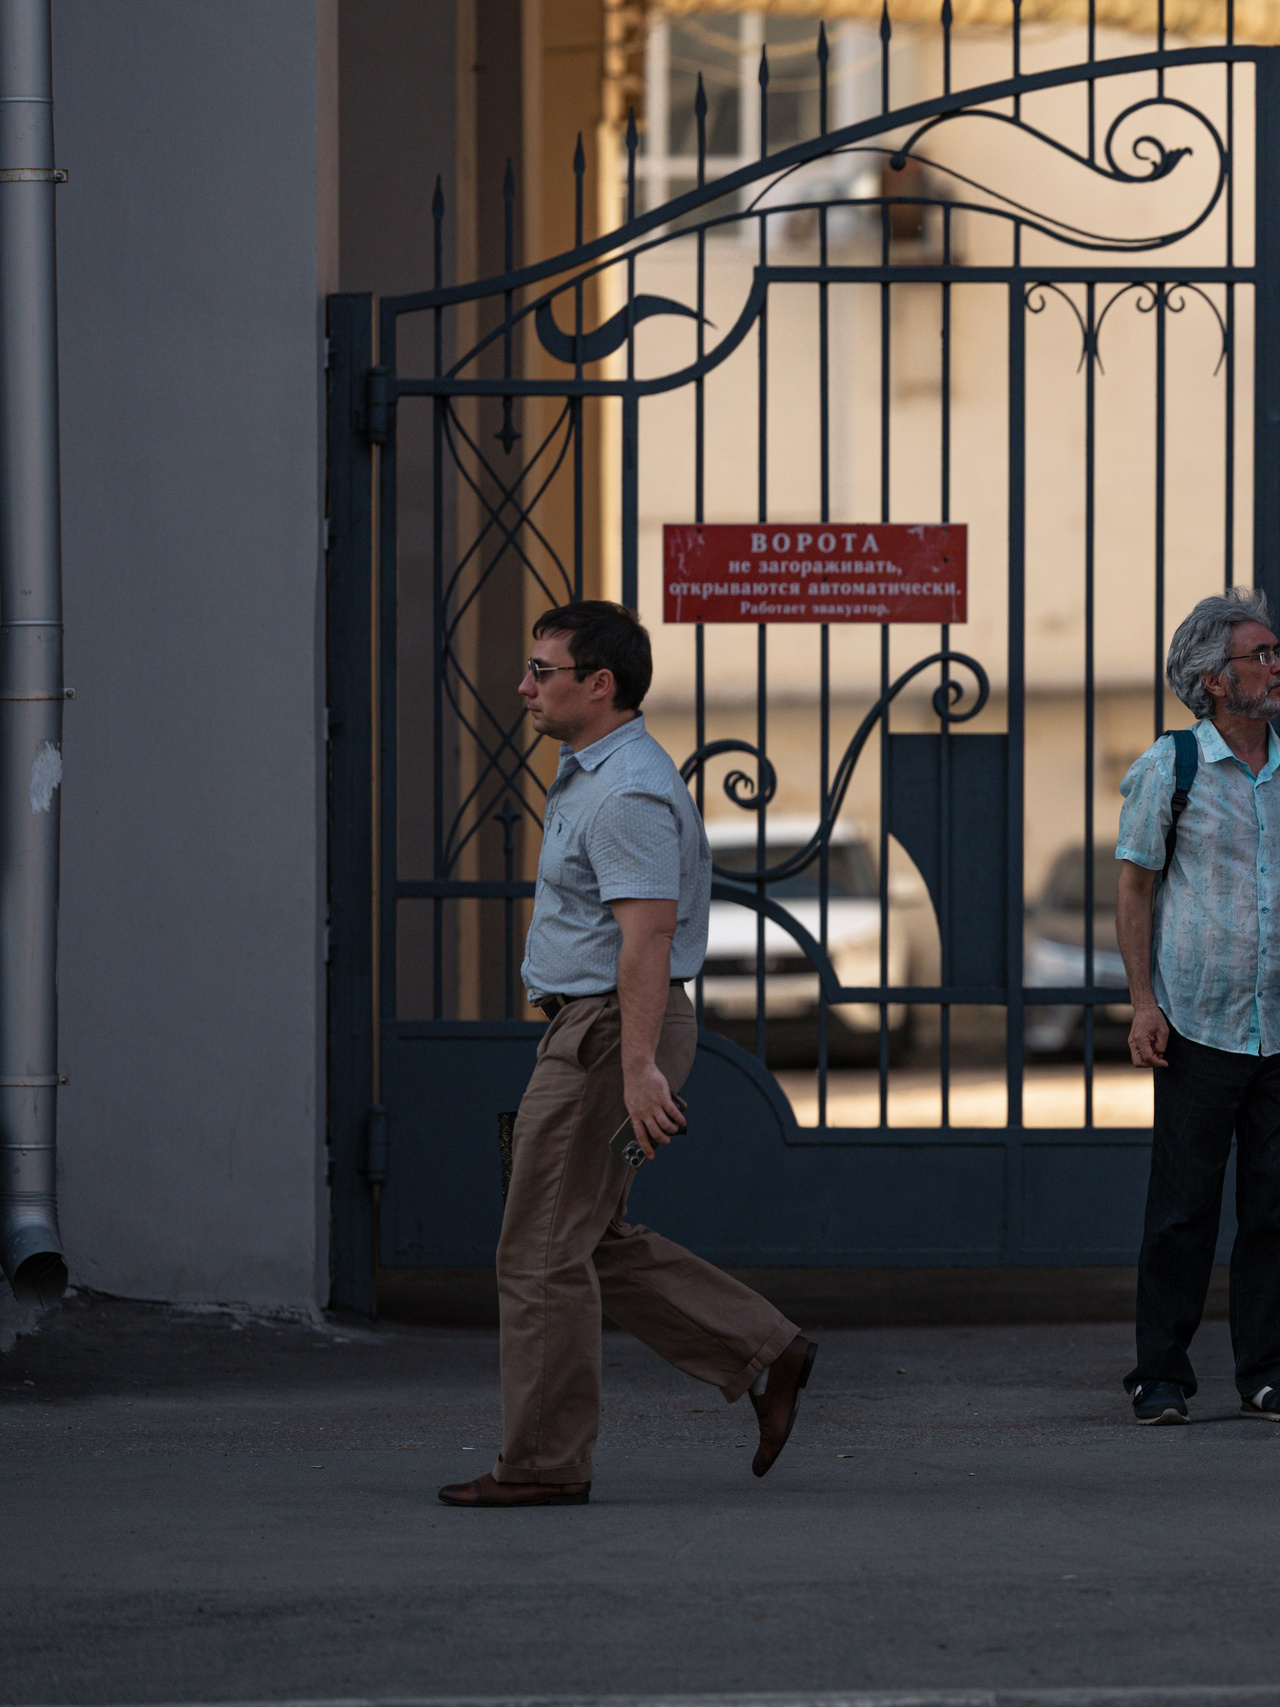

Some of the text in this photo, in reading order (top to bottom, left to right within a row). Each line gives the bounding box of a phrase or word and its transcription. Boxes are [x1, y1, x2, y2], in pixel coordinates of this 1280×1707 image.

[750, 532, 879, 553] ВОРОТА
[728, 560, 903, 578] не загораживать,
[669, 582, 962, 600] открываются автоматически.
[740, 601, 890, 618] Работает эвакуатор.
